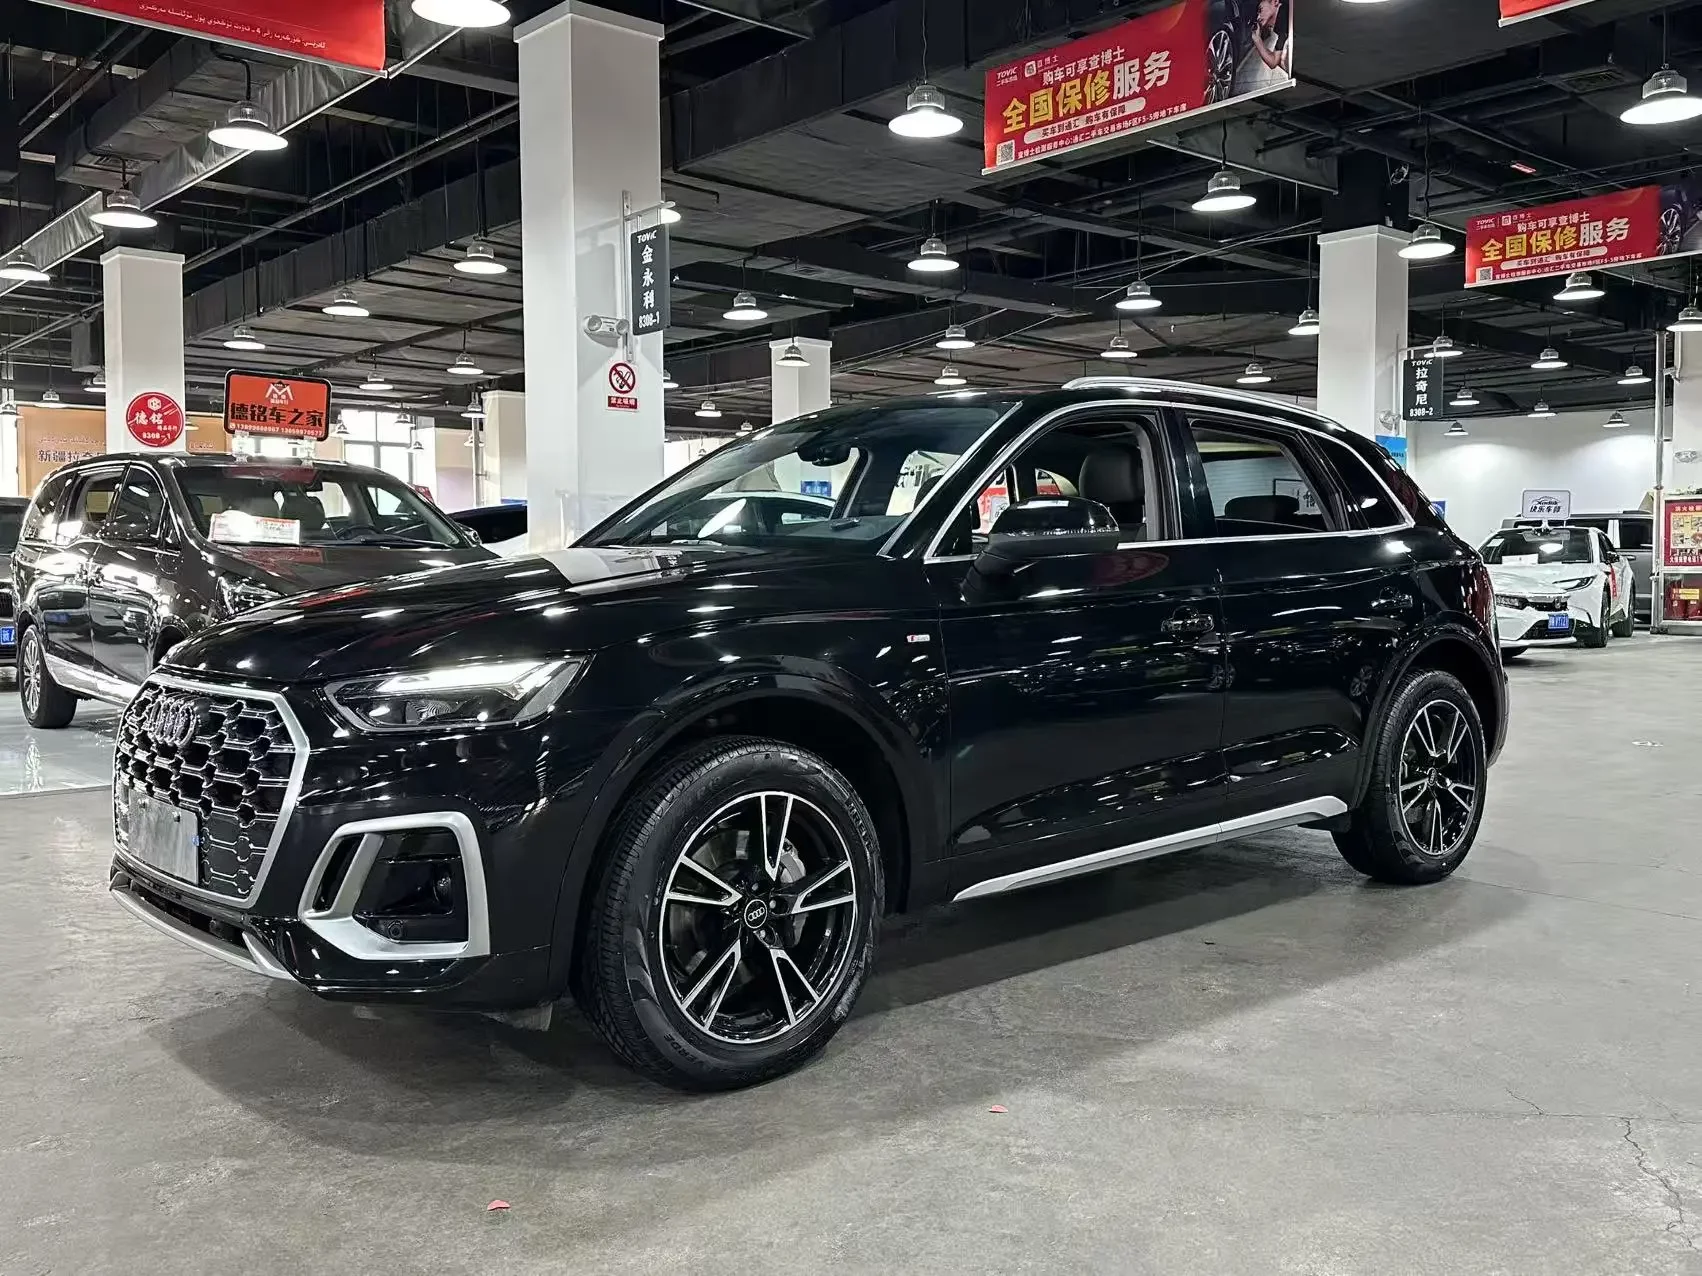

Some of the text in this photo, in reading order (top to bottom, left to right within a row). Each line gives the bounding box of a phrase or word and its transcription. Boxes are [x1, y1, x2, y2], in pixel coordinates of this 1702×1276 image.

[996, 66, 1018, 79] TOVIC
[1042, 46, 1125, 87] 购车可享查博士
[1003, 50, 1171, 134] 全国保修服务
[1042, 104, 1126, 138] 买车到通汇 购车有保障
[637, 230, 657, 243] TOVIC
[1517, 211, 1590, 233] 购车可享查博士
[1481, 217, 1630, 262] 全国保修服务
[641, 244, 655, 309] 金永利
[1411, 359, 1433, 367] TOVIC
[1415, 367, 1428, 406] 拉奇尼
[230, 402, 324, 427] 德铭车之家
[1409, 407, 1433, 417] 8308-2
